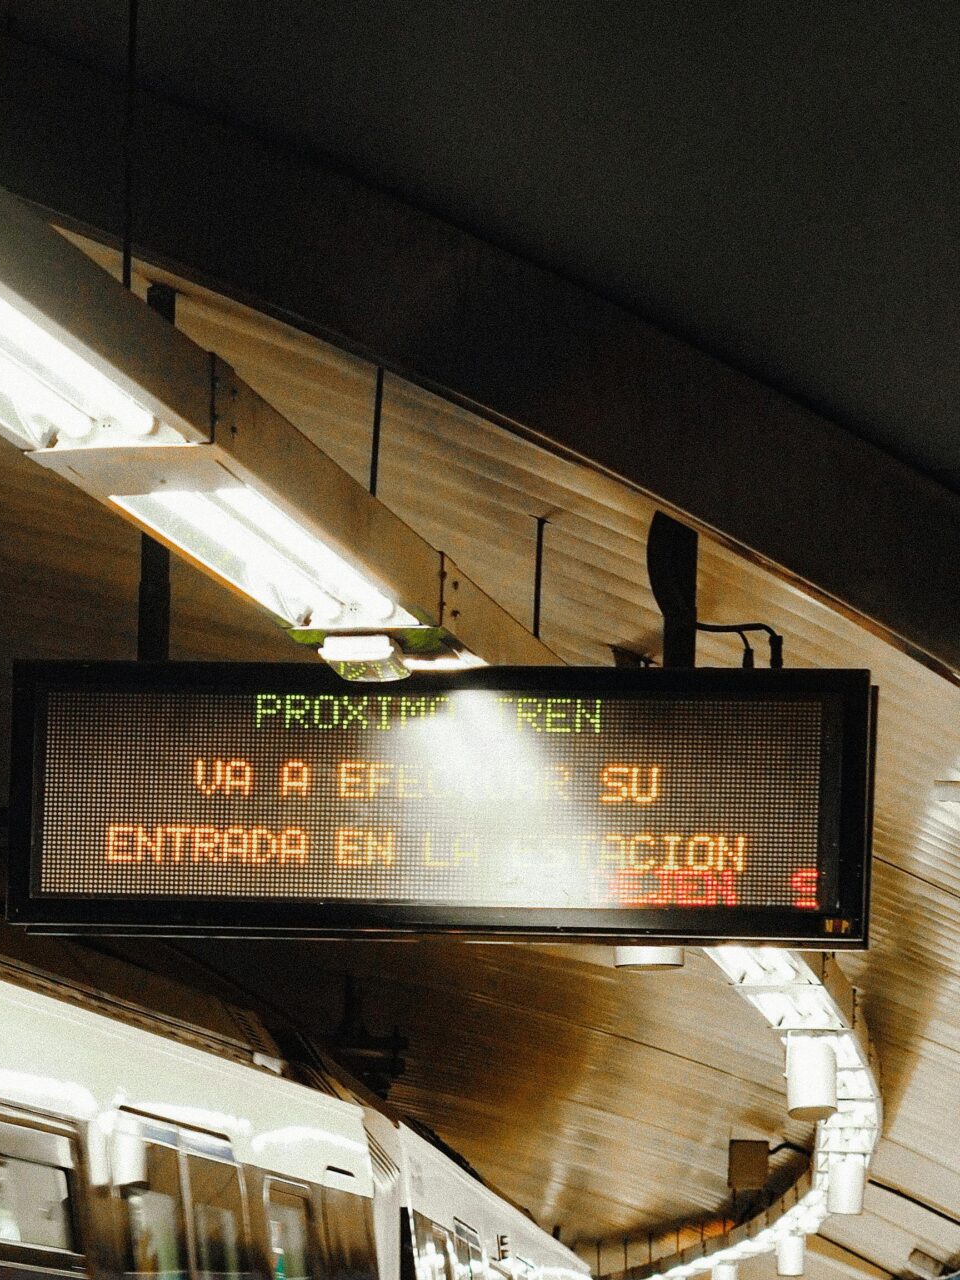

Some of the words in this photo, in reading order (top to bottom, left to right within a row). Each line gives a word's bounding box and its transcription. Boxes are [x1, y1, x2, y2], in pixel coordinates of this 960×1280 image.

[194, 758, 254, 797] VA
[279, 757, 312, 799] A
[600, 763, 662, 803] SU
[106, 822, 309, 864] ENTRADA
[336, 825, 394, 869] EN
